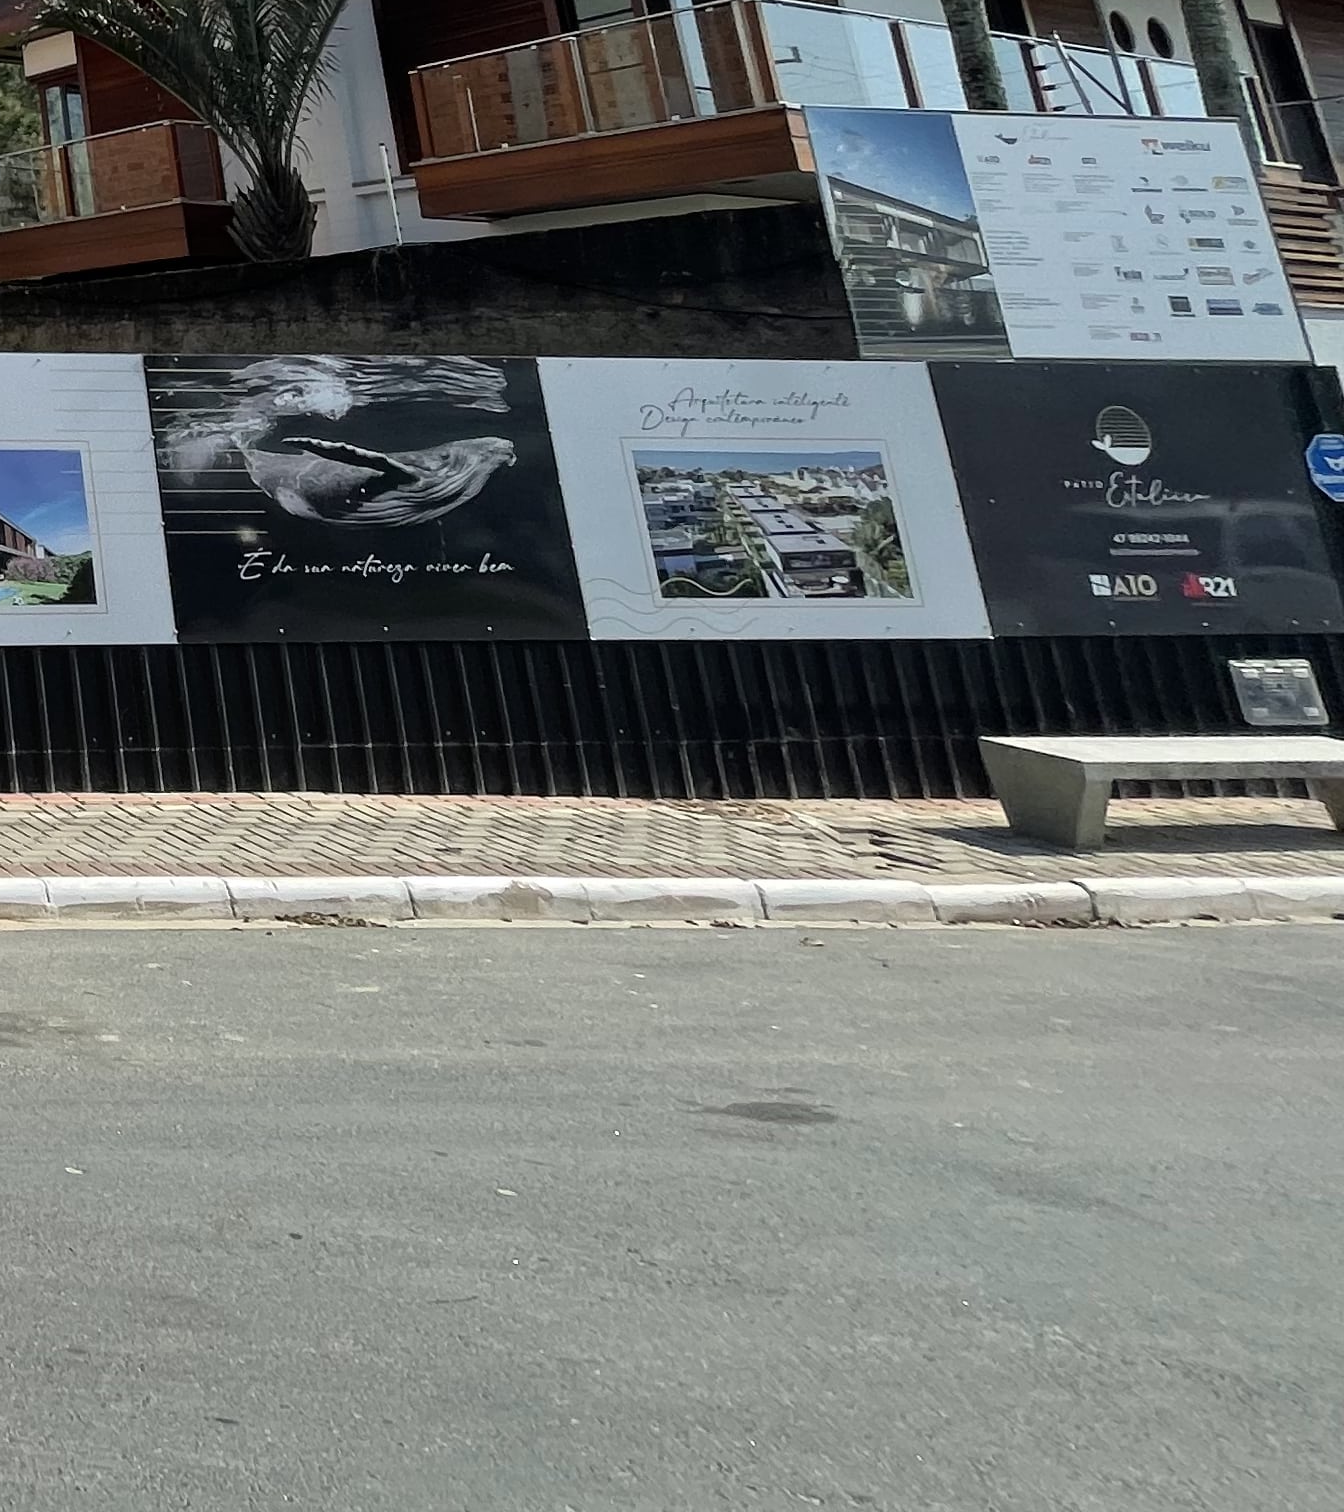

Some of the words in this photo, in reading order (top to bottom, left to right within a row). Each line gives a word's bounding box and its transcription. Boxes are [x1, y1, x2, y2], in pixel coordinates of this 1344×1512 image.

[271, 554, 297, 574] da
[304, 563, 334, 574] sua
[341, 554, 417, 583] natureza
[478, 553, 515, 574] bem
